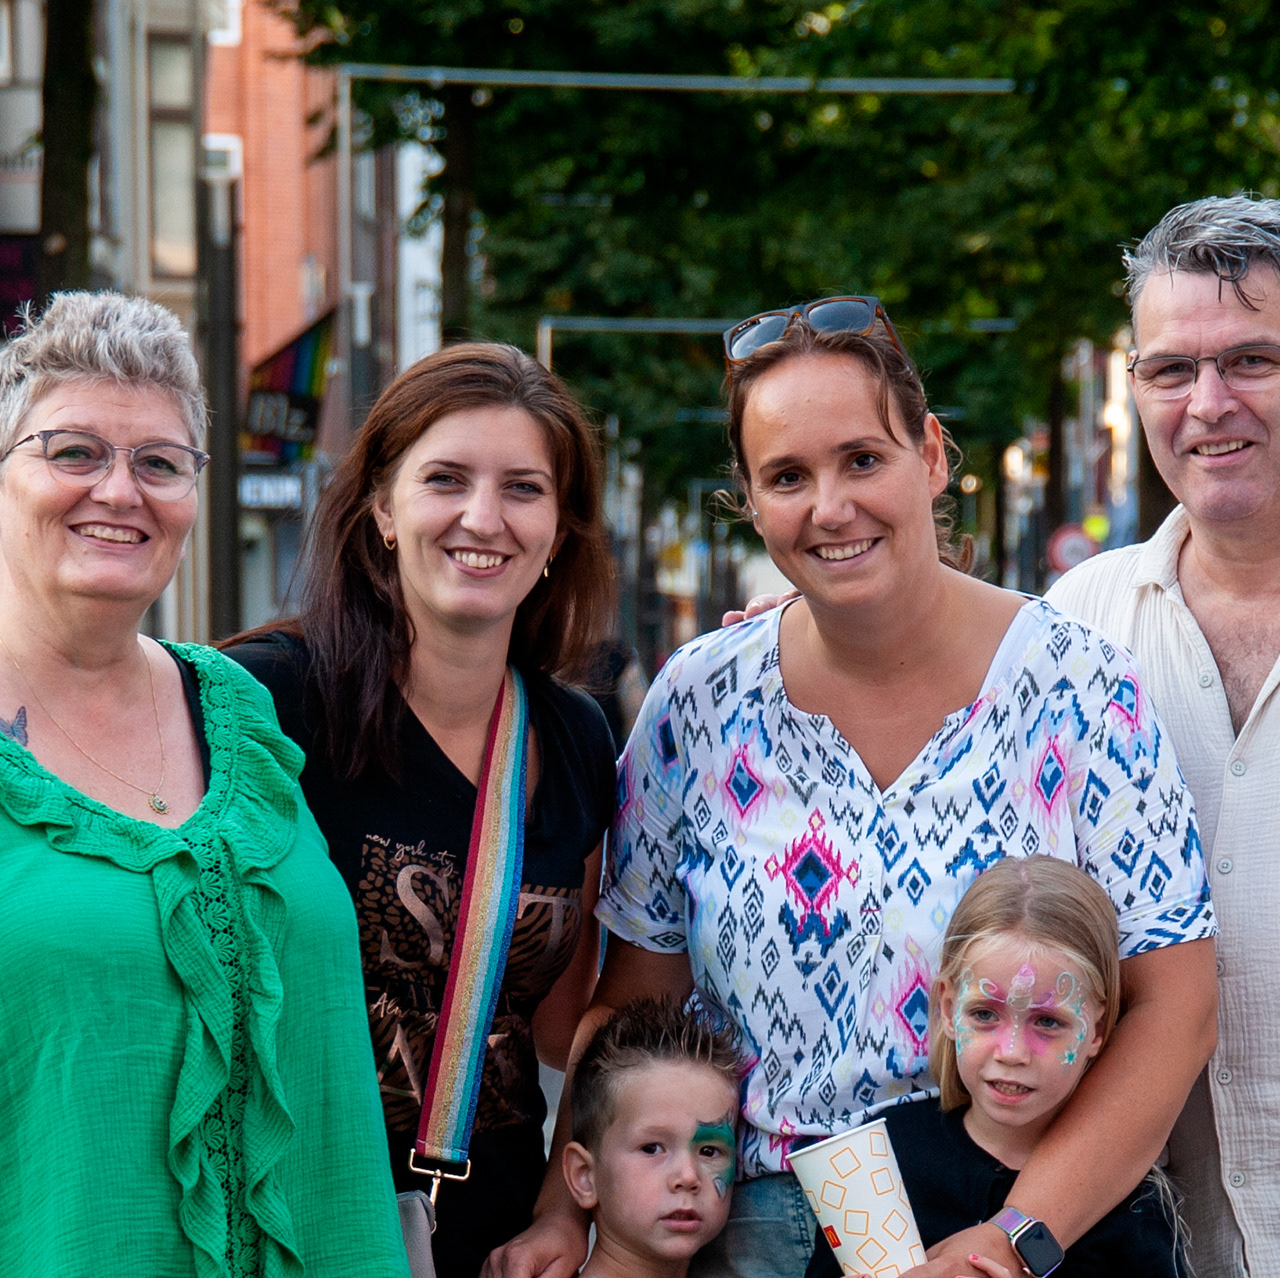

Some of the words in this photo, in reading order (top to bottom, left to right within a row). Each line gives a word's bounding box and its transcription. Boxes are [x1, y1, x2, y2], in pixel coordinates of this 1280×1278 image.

[365, 833, 391, 847] new
[394, 839, 427, 862] york
[429, 850, 457, 877] city
